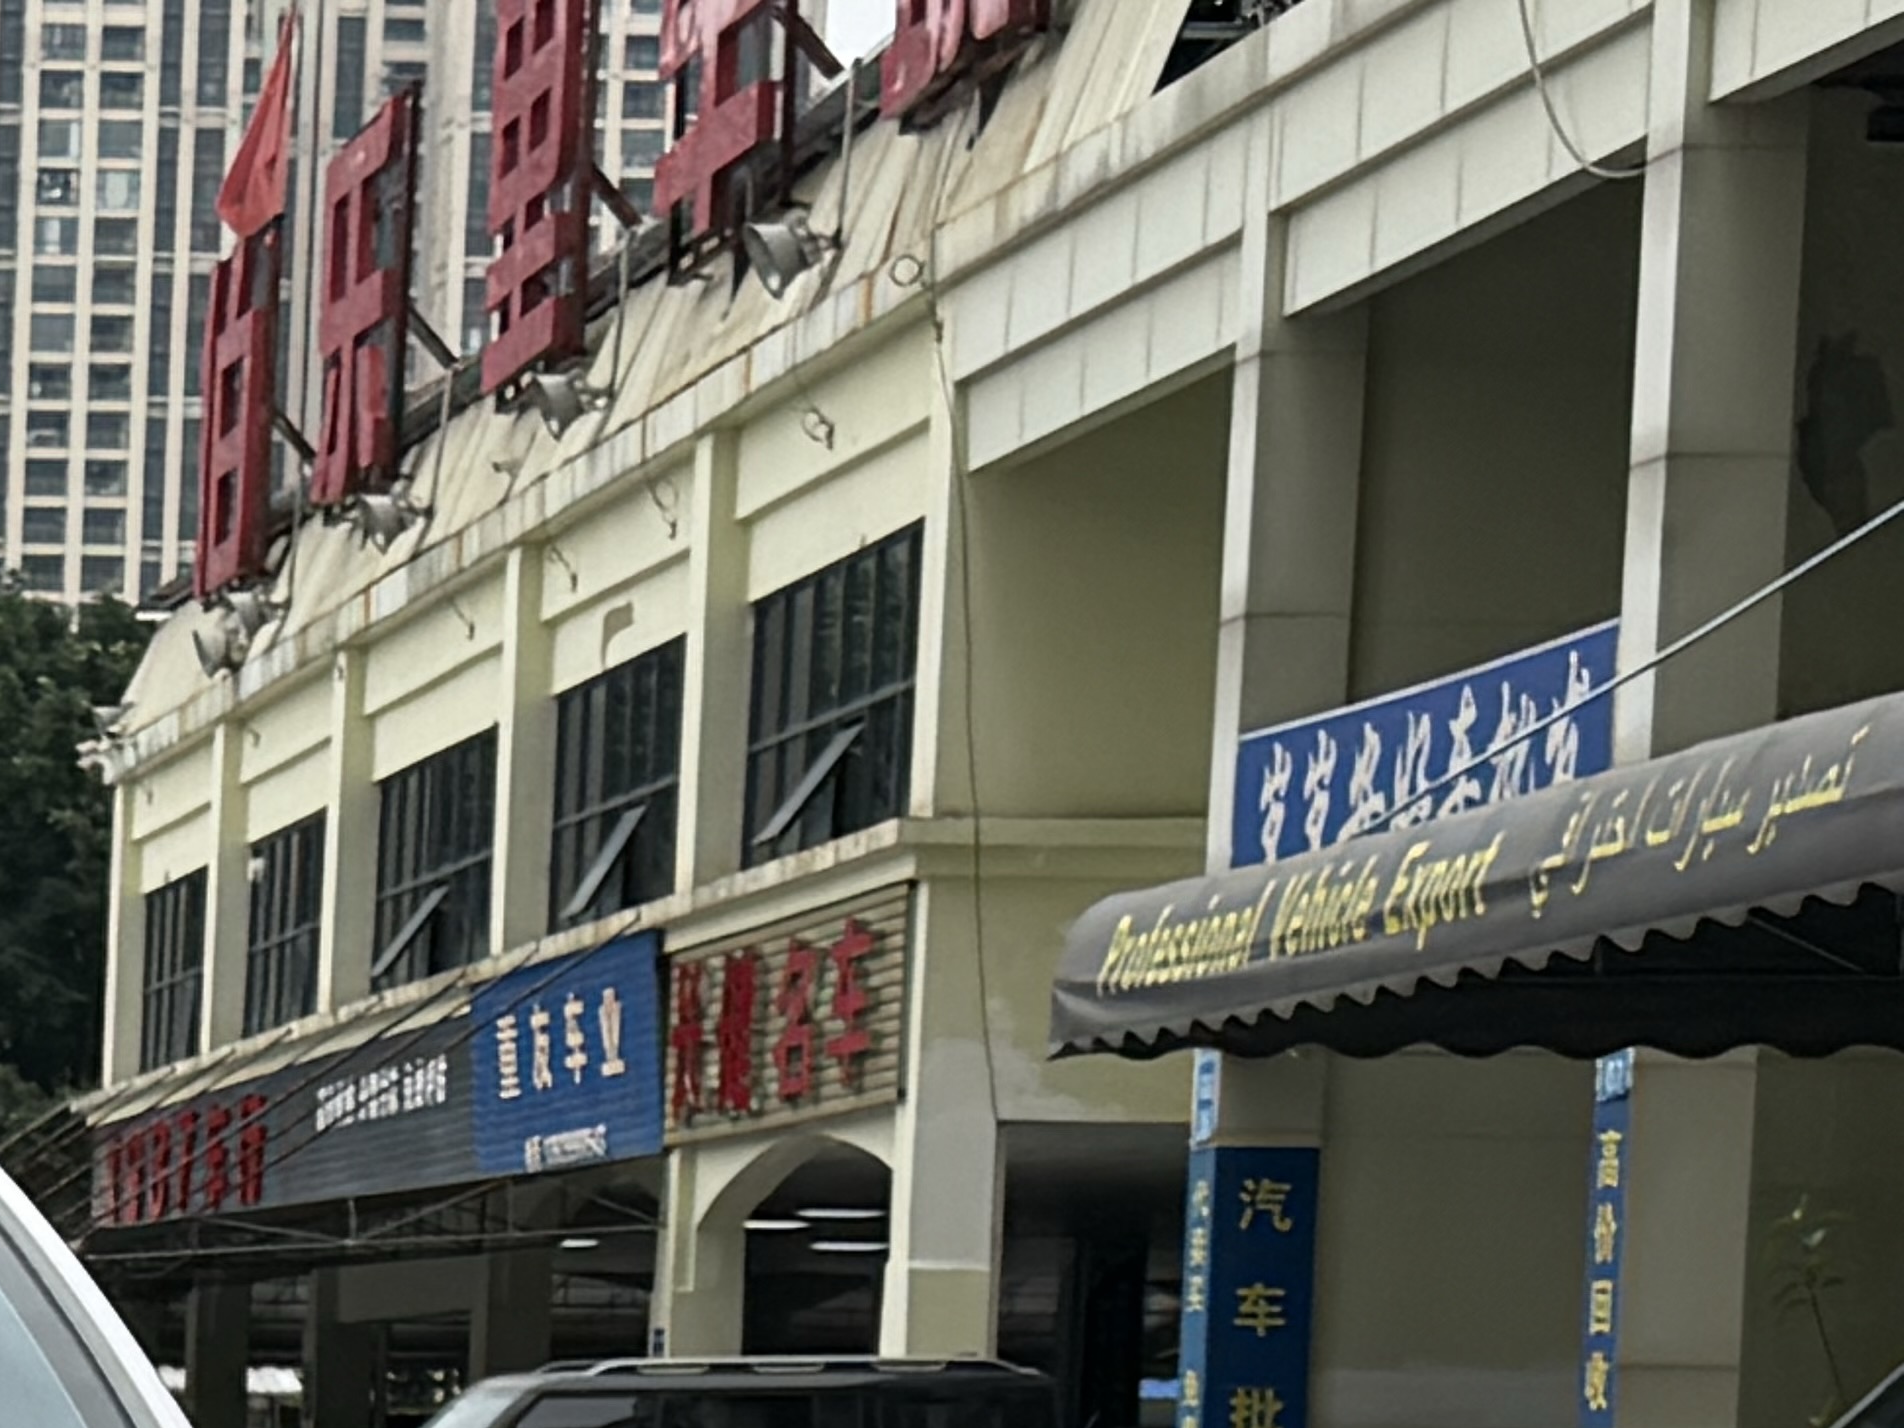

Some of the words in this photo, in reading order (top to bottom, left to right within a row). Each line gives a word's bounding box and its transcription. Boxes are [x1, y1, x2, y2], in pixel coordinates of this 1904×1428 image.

[1096, 878, 1278, 997] Professional
[1269, 853, 1379, 962] Vehicle
[1383, 830, 1506, 952] Export
